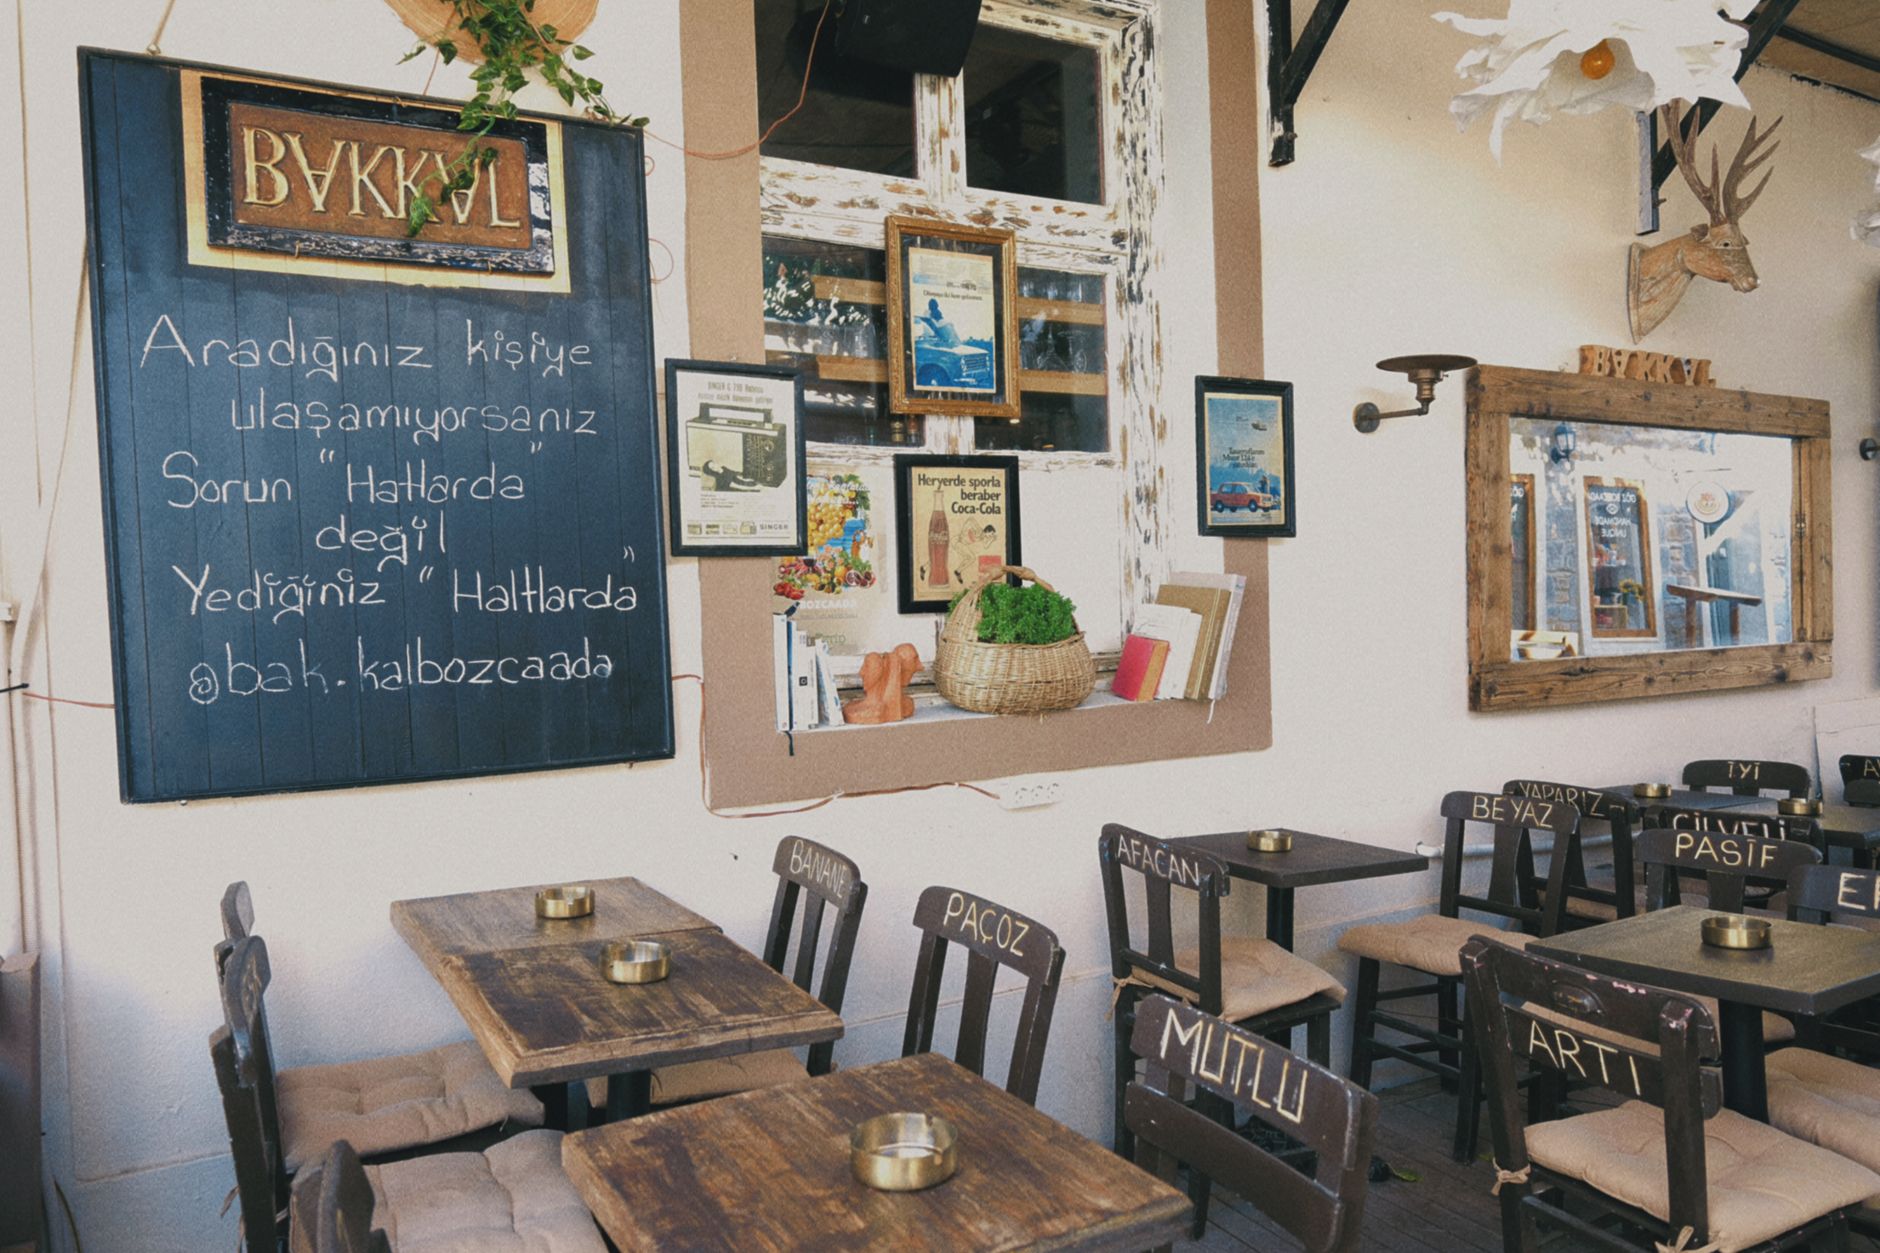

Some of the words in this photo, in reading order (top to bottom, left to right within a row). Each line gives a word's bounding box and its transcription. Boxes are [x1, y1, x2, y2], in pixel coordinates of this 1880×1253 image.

[162, 451, 292, 509] Sorun
[917, 473, 967, 490] Heryerde
[968, 475, 1001, 491] sporla
[960, 488, 1001, 500] beraber
[759, 523, 789, 531] SINGER
[951, 501, 1001, 515] Coca-Cola
[316, 510, 447, 572] değil
[1472, 795, 1553, 829] BEYAZ
[1117, 832, 1200, 886] AFACAN
[944, 892, 1031, 957] PAÇOZ
[1160, 1008, 1309, 1125] MUTLU
[1528, 1020, 1642, 1097] ARTI
